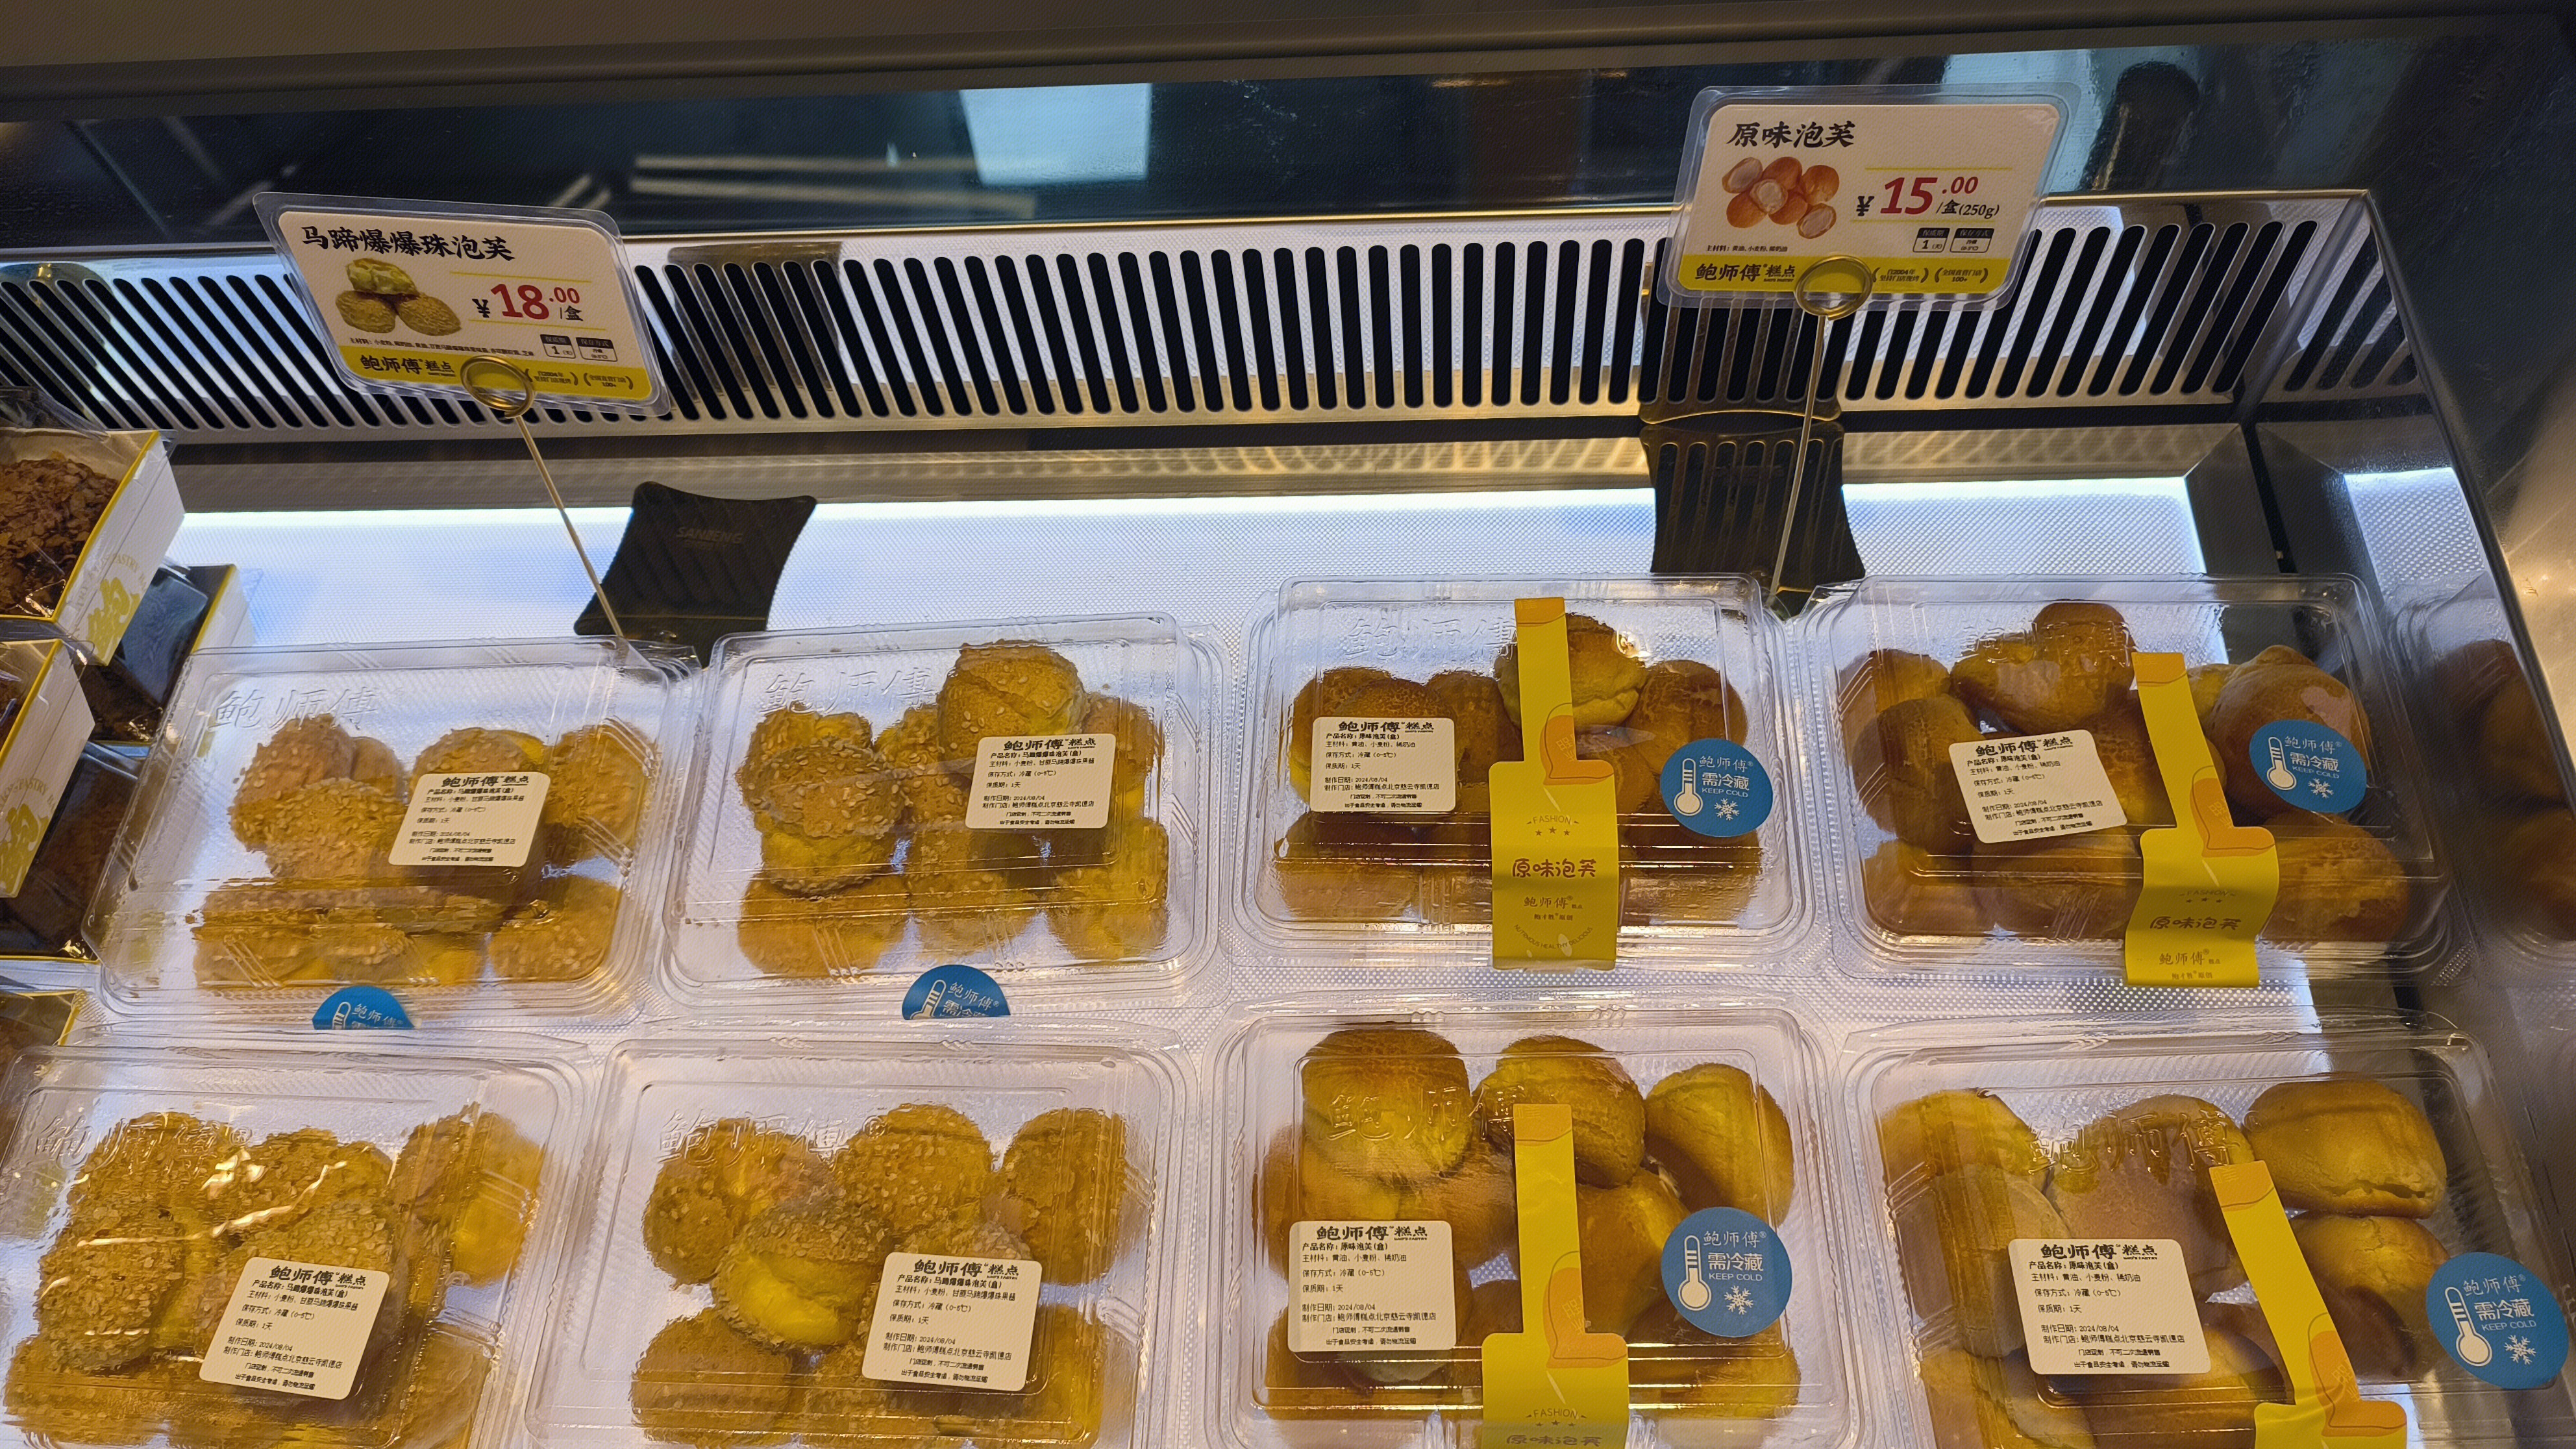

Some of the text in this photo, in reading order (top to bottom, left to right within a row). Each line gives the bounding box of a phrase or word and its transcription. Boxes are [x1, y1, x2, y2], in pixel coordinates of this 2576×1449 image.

[1727, 121, 1856, 148] 原味泡芙
[301, 225, 515, 261] 马蹄爆爆珠泡芙
[2290, 752, 2340, 772] 需冷藏
[1702, 773, 1750, 791] 需冷藏
[2316, 770, 2339, 778] COLD
[1726, 789, 1748, 798] COLD
[1533, 815, 1571, 824] FASHION
[1512, 858, 1596, 878] 原味泡芙
[2149, 916, 2241, 930] 原味泡芙
[943, 999, 989, 1017] 需冷
[1707, 1252, 1764, 1272] 需冷藏
[1737, 1273, 1763, 1282] COLD
[2474, 1298, 2534, 1320] 需冷藏
[2481, 1320, 2536, 1331] KEEP COLD
[1533, 1407, 1579, 1420] FASHION
[1506, 1434, 1603, 1447] 原味泡芙
